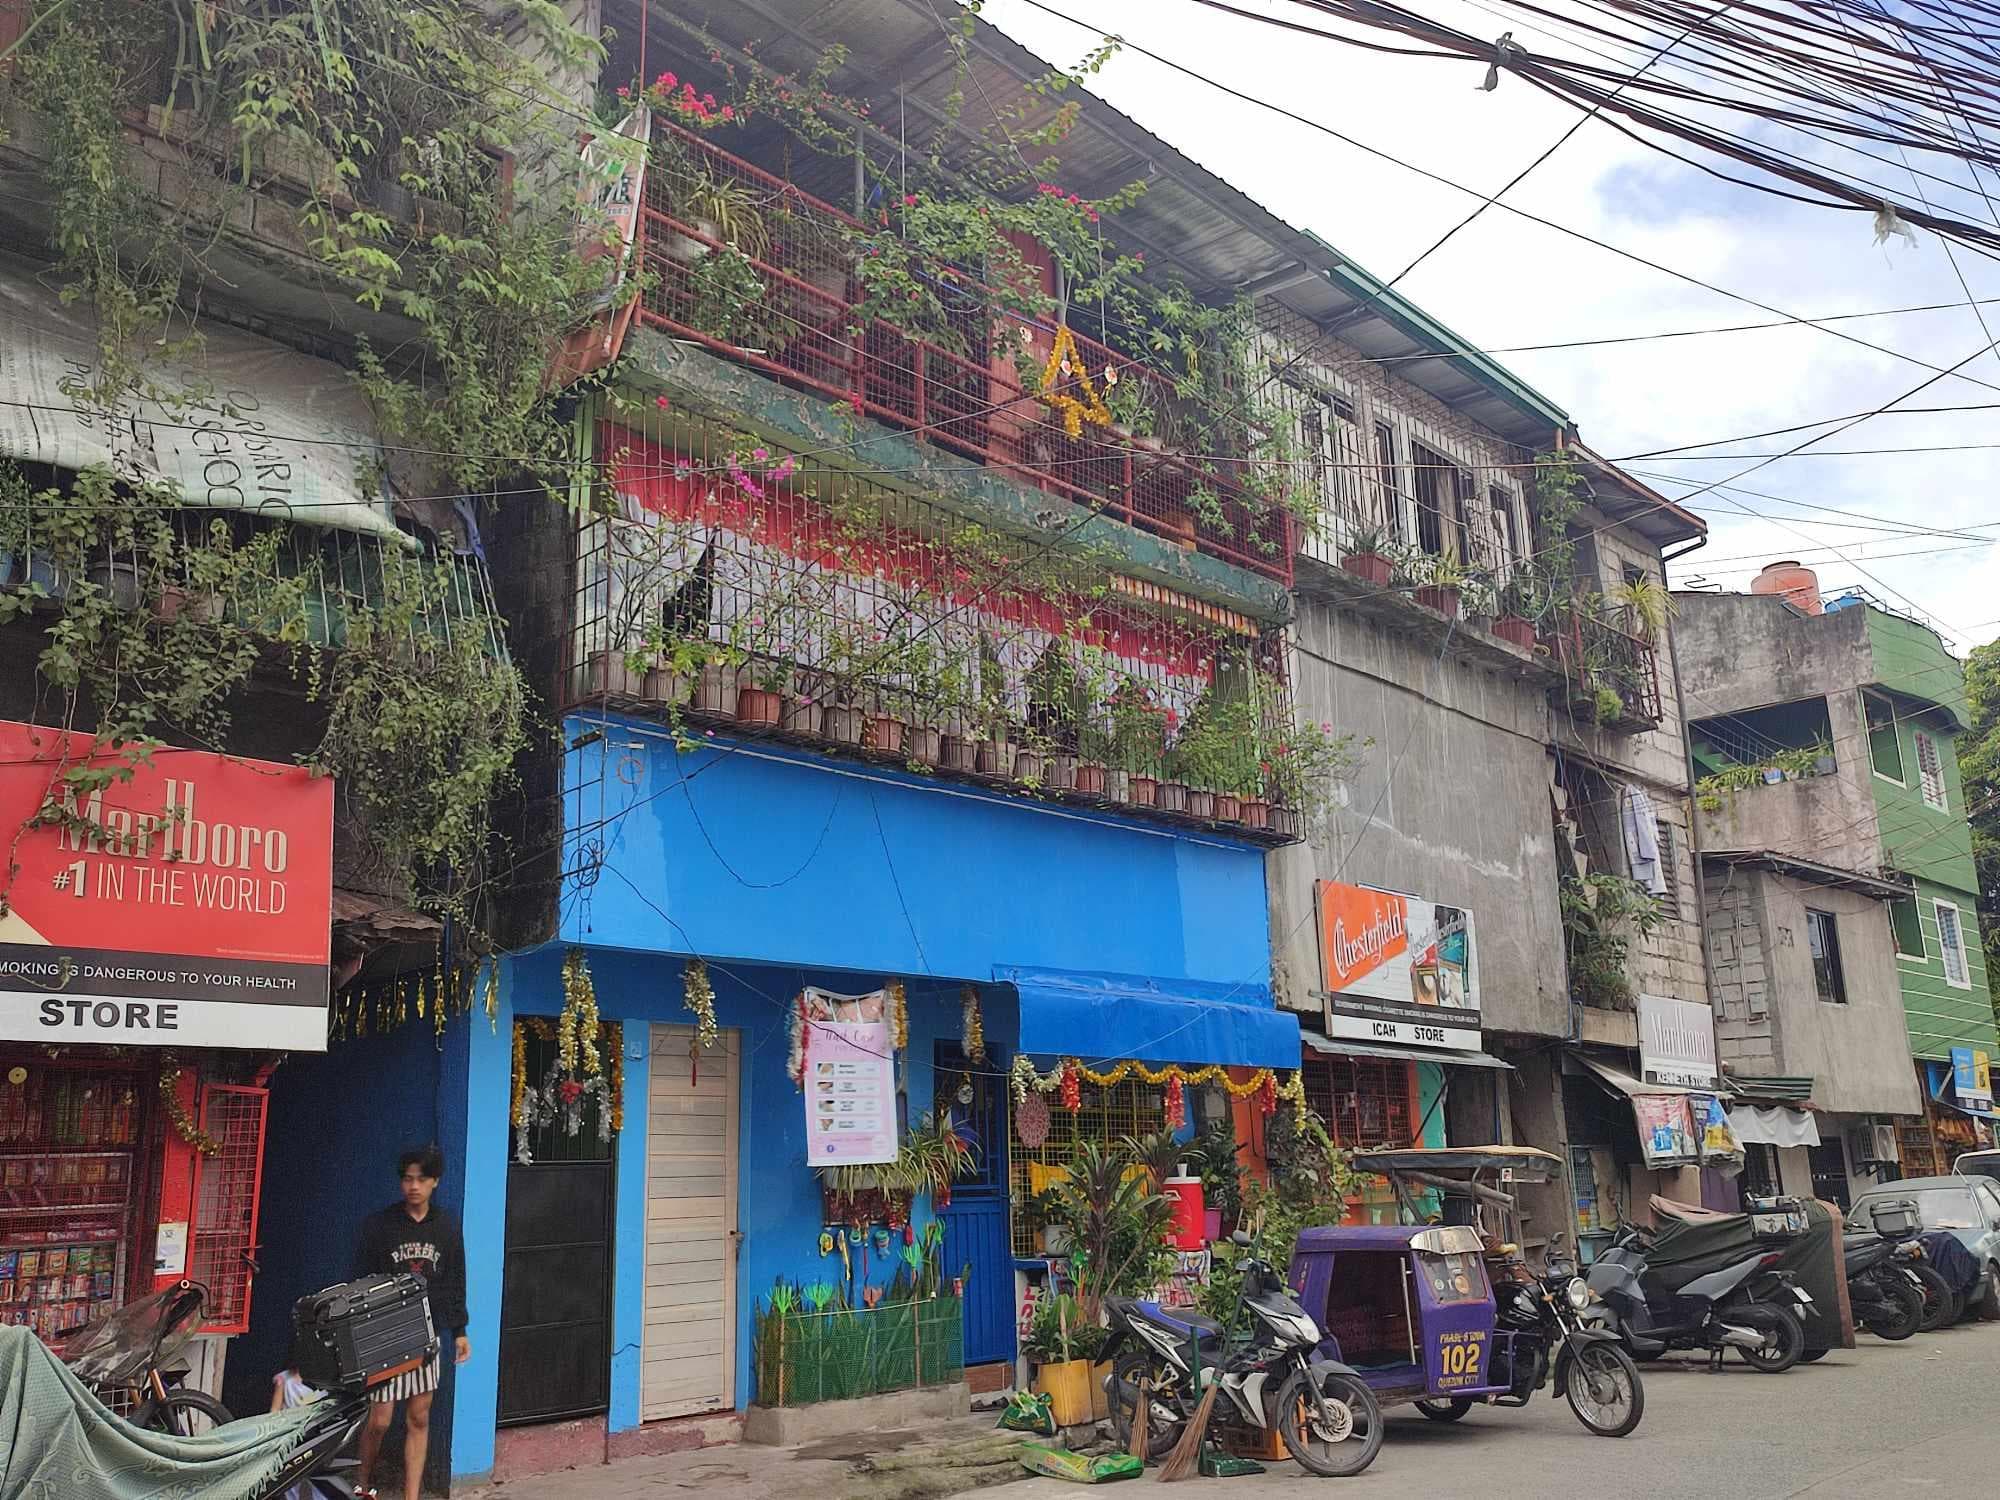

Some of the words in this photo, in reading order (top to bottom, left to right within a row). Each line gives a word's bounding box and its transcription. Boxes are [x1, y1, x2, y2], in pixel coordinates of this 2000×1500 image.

[57, 778, 289, 873] Marlboro
[52, 860, 88, 897] #1
[97, 863, 125, 900] IN
[133, 866, 185, 906] THE
[192, 872, 287, 914] WORLD
[1333, 898, 1405, 980] Chesterfield
[84, 965, 176, 983] DANGEROUS
[180, 971, 199, 984] TO
[203, 973, 241, 987] YOUR
[246, 976, 297, 990] HEALTH
[39, 998, 179, 1030] STORE
[1372, 1022, 1397, 1038] ICAH
[1414, 1026, 1446, 1042] STORE
[1650, 1003, 1708, 1058] Marlboro
[1441, 1343, 1480, 1375] 102
